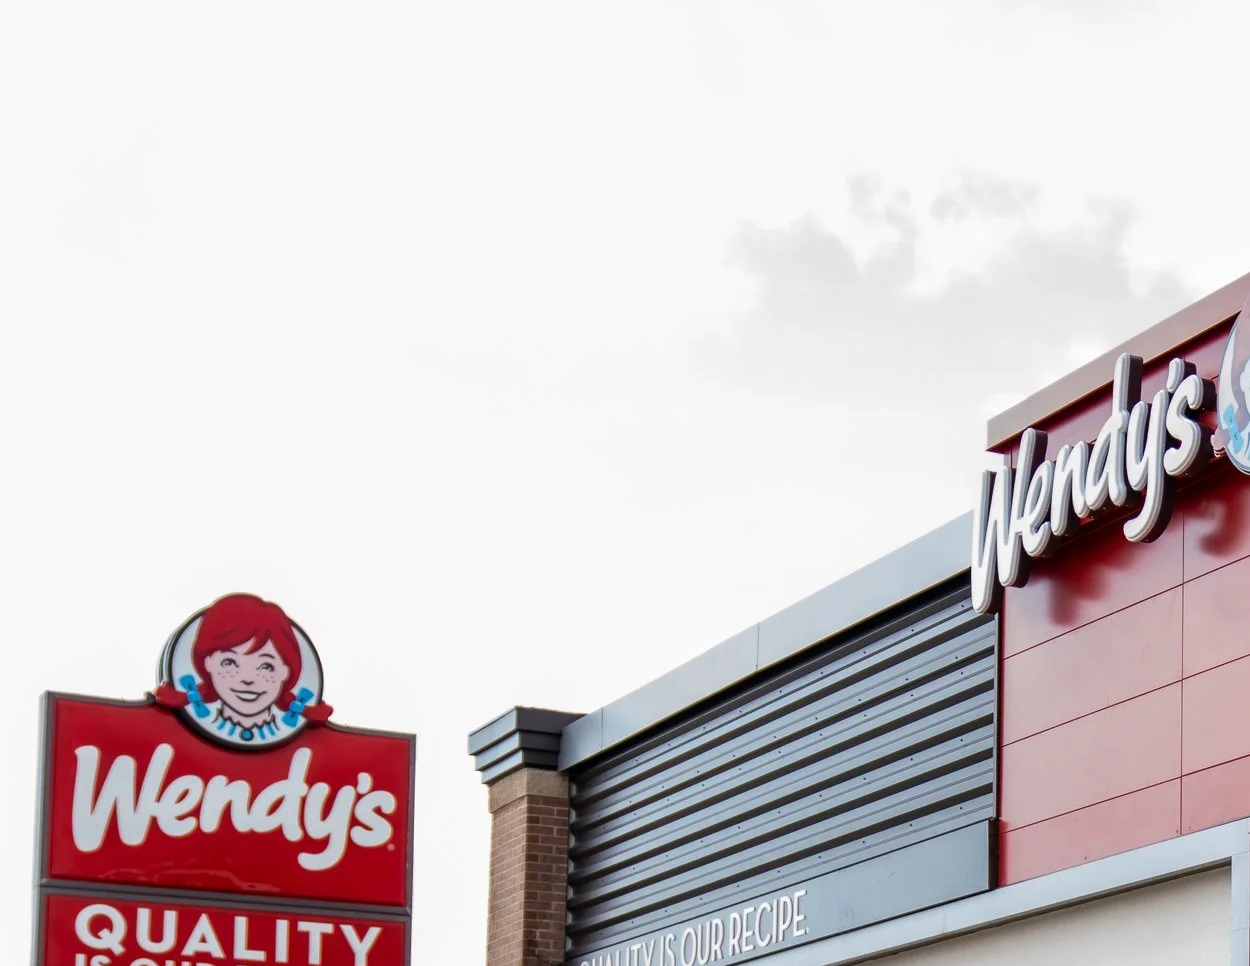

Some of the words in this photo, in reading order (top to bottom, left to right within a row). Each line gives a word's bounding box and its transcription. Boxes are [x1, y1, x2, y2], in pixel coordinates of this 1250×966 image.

[971, 353, 1203, 614] Wendy's
[72, 742, 396, 871] Wendy's
[729, 889, 808, 957] RECIPE
